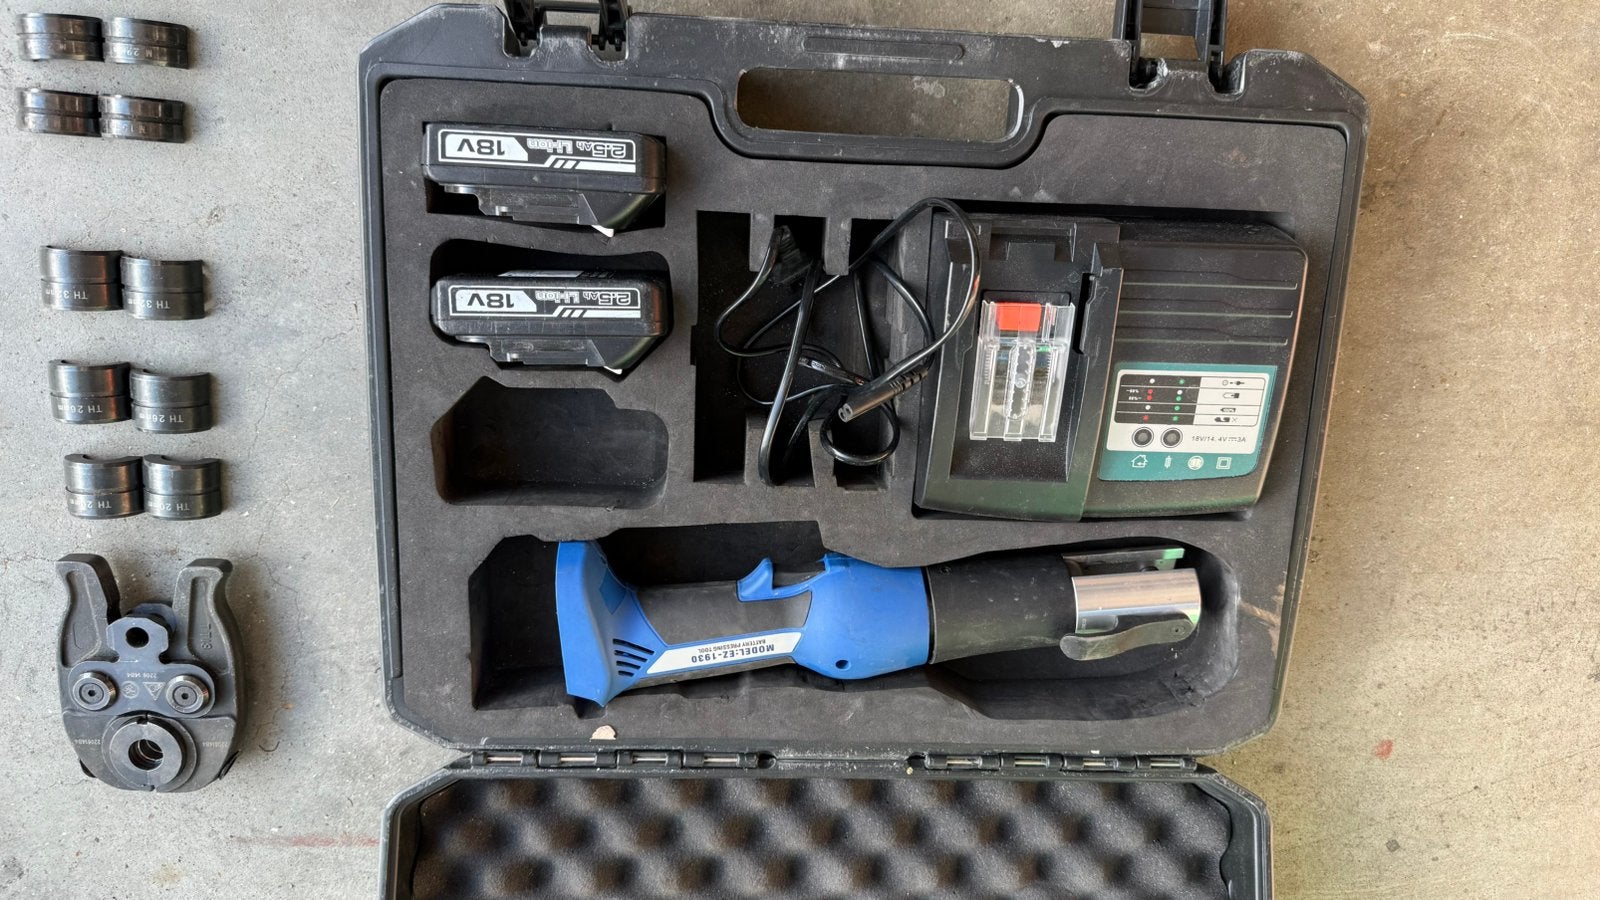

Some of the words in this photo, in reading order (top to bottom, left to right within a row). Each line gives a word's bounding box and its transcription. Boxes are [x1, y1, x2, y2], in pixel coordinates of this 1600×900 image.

[457, 138, 506, 156] 18V
[526, 138, 573, 154] Li-ion
[576, 141, 626, 158] 2.5Ah
[73, 290, 88, 300] TH
[535, 290, 579, 304] Li-ion
[583, 291, 631, 306] 2.5Ah
[156, 300, 170, 309] TH
[467, 293, 515, 309] 18V
[87, 405, 102, 413] TH
[169, 414, 184, 423] TH
[97, 500, 112, 509] TH
[176, 502, 190, 511] TH
[713, 643, 740, 651] PRESSING
[742, 639, 766, 648] BATTERY
